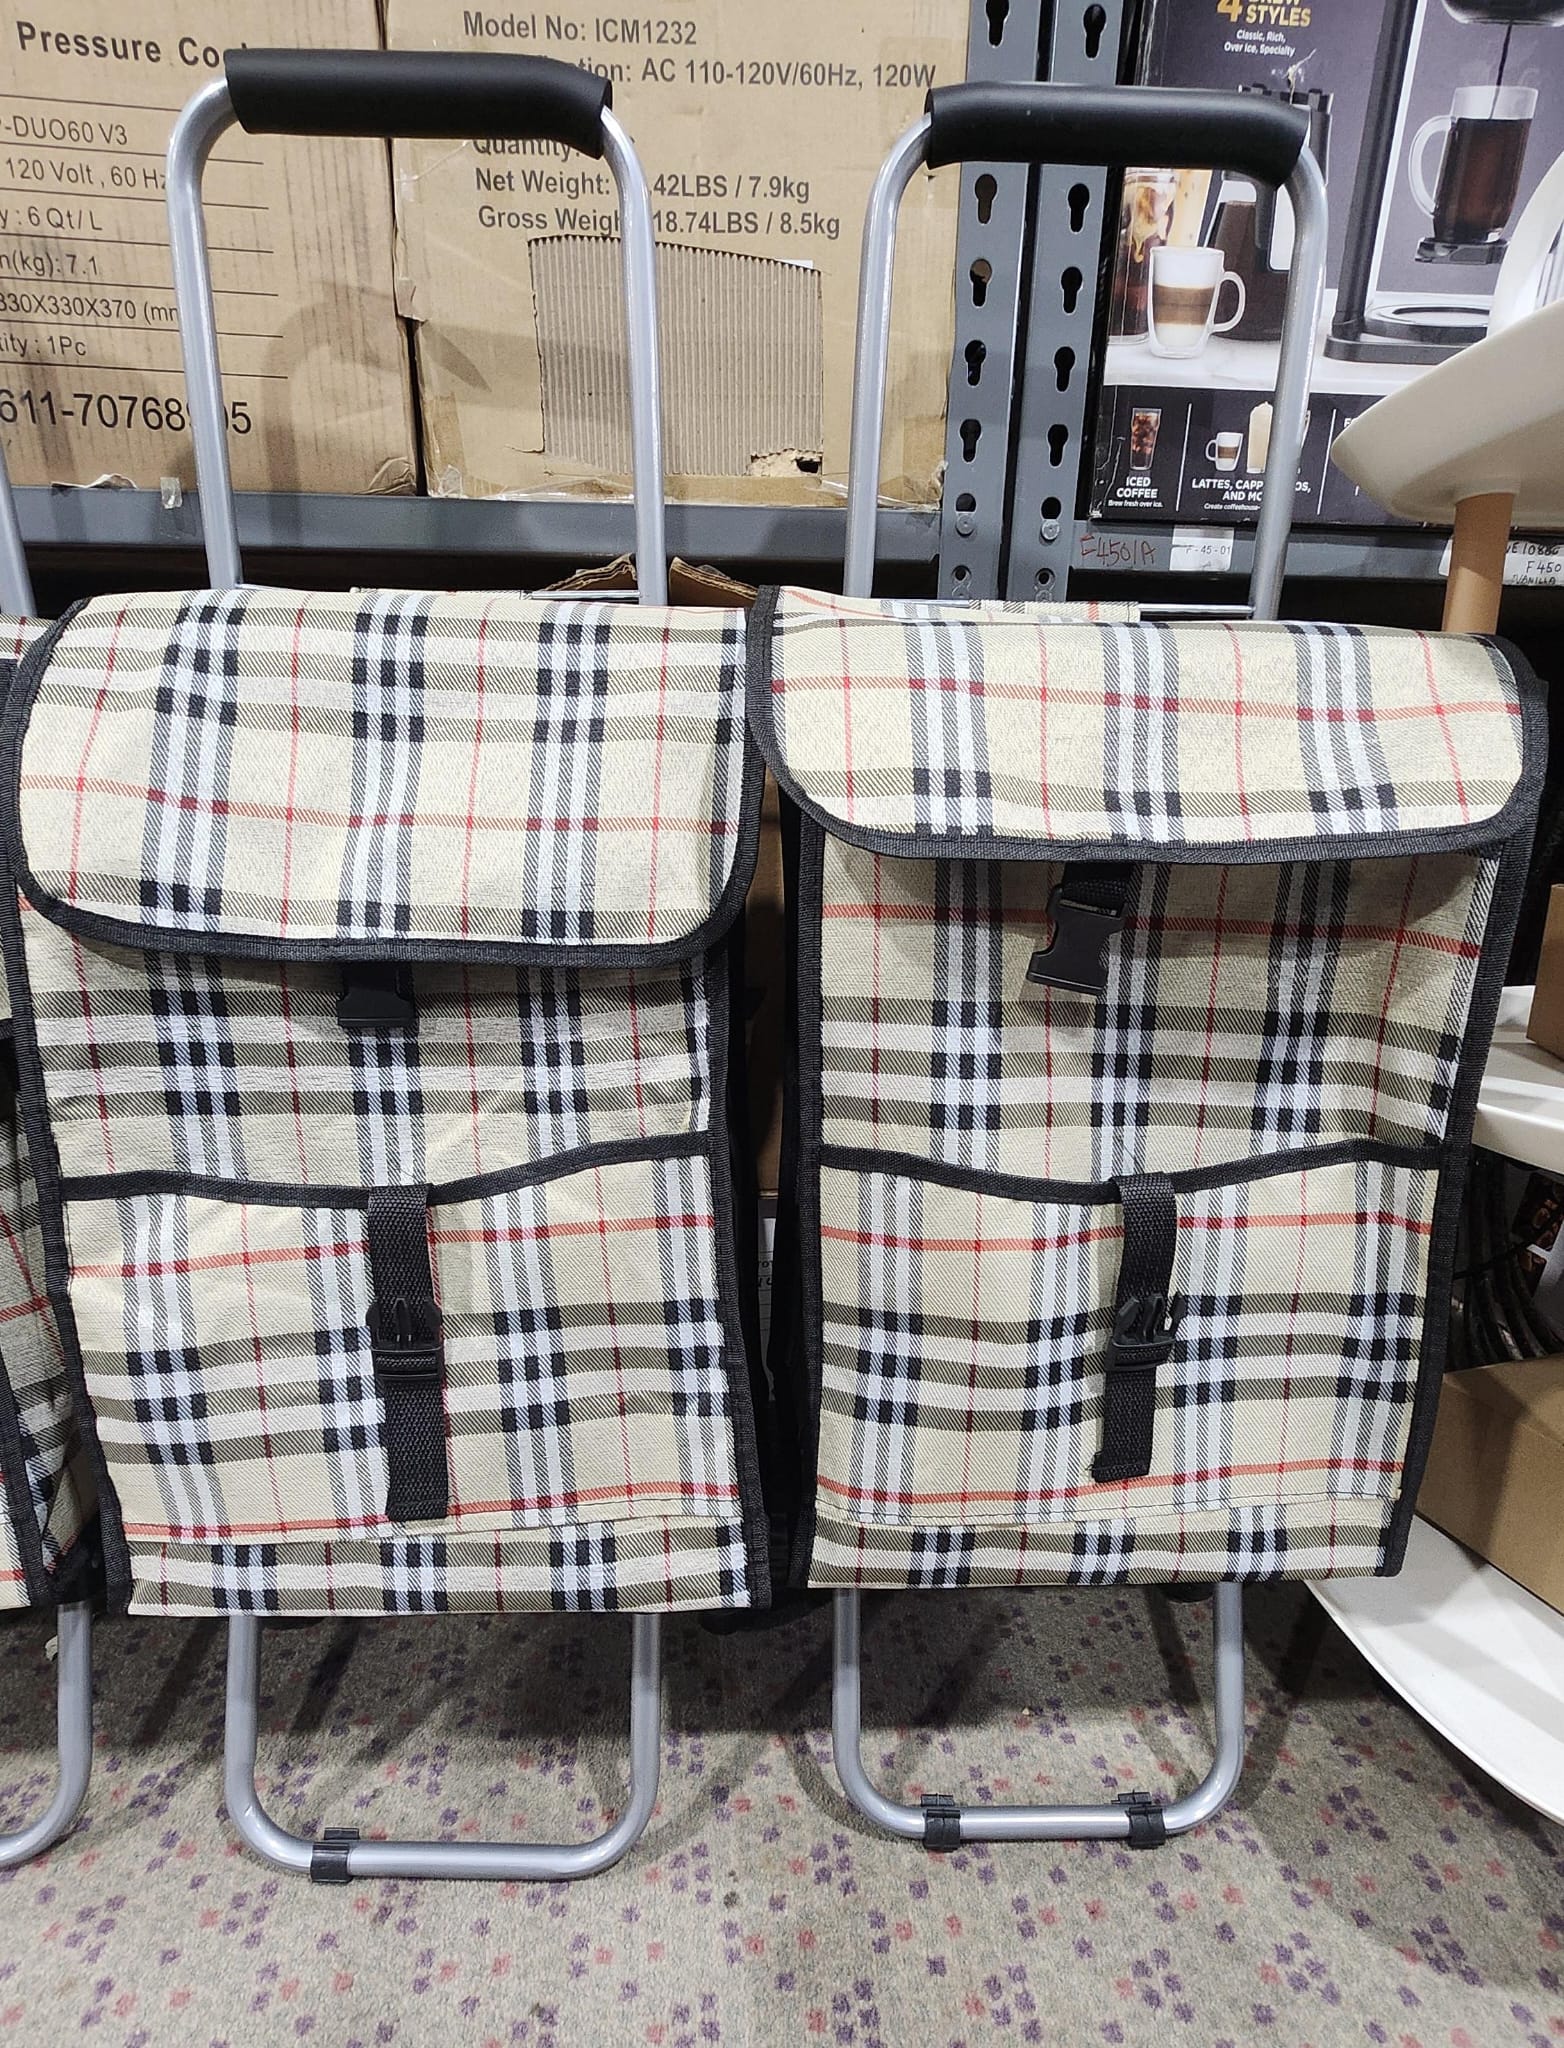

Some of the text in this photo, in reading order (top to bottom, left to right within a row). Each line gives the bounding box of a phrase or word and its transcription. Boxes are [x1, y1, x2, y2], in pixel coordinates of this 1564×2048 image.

[463, 10, 697, 45] Model No: ICM1232
[1245, 4, 1311, 27] STYLES
[16, 20, 161, 63] Pressure
[1224, 41, 1243, 52] Over
[1259, 44, 1296, 58] Specialty
[1236, 29, 1286, 43] Classic, Rich,
[641, 58, 676, 82] AC
[685, 59, 863, 90] 110-120V/60Hz,
[873, 63, 936, 88] 120W
[0, 115, 128, 146] -DUO60 V3
[6, 157, 45, 180] 120
[111, 165, 137, 188] 60
[475, 167, 515, 191] Net
[522, 170, 610, 199] Weight:
[649, 174, 728, 198] .42LBS
[749, 175, 810, 204] 7.9kg
[478, 205, 548, 229] Gross
[652, 210, 758, 235] 18.74LBS
[780, 211, 840, 240] 8.5kg
[47, 334, 87, 357] 1Pc
[0, 388, 252, 434] 611-707685
[1116, 487, 1158, 499] COFFEE
[1126, 476, 1151, 487] ICED
[1191, 478, 1233, 491] LATTES,
[1222, 491, 1246, 501] AND
